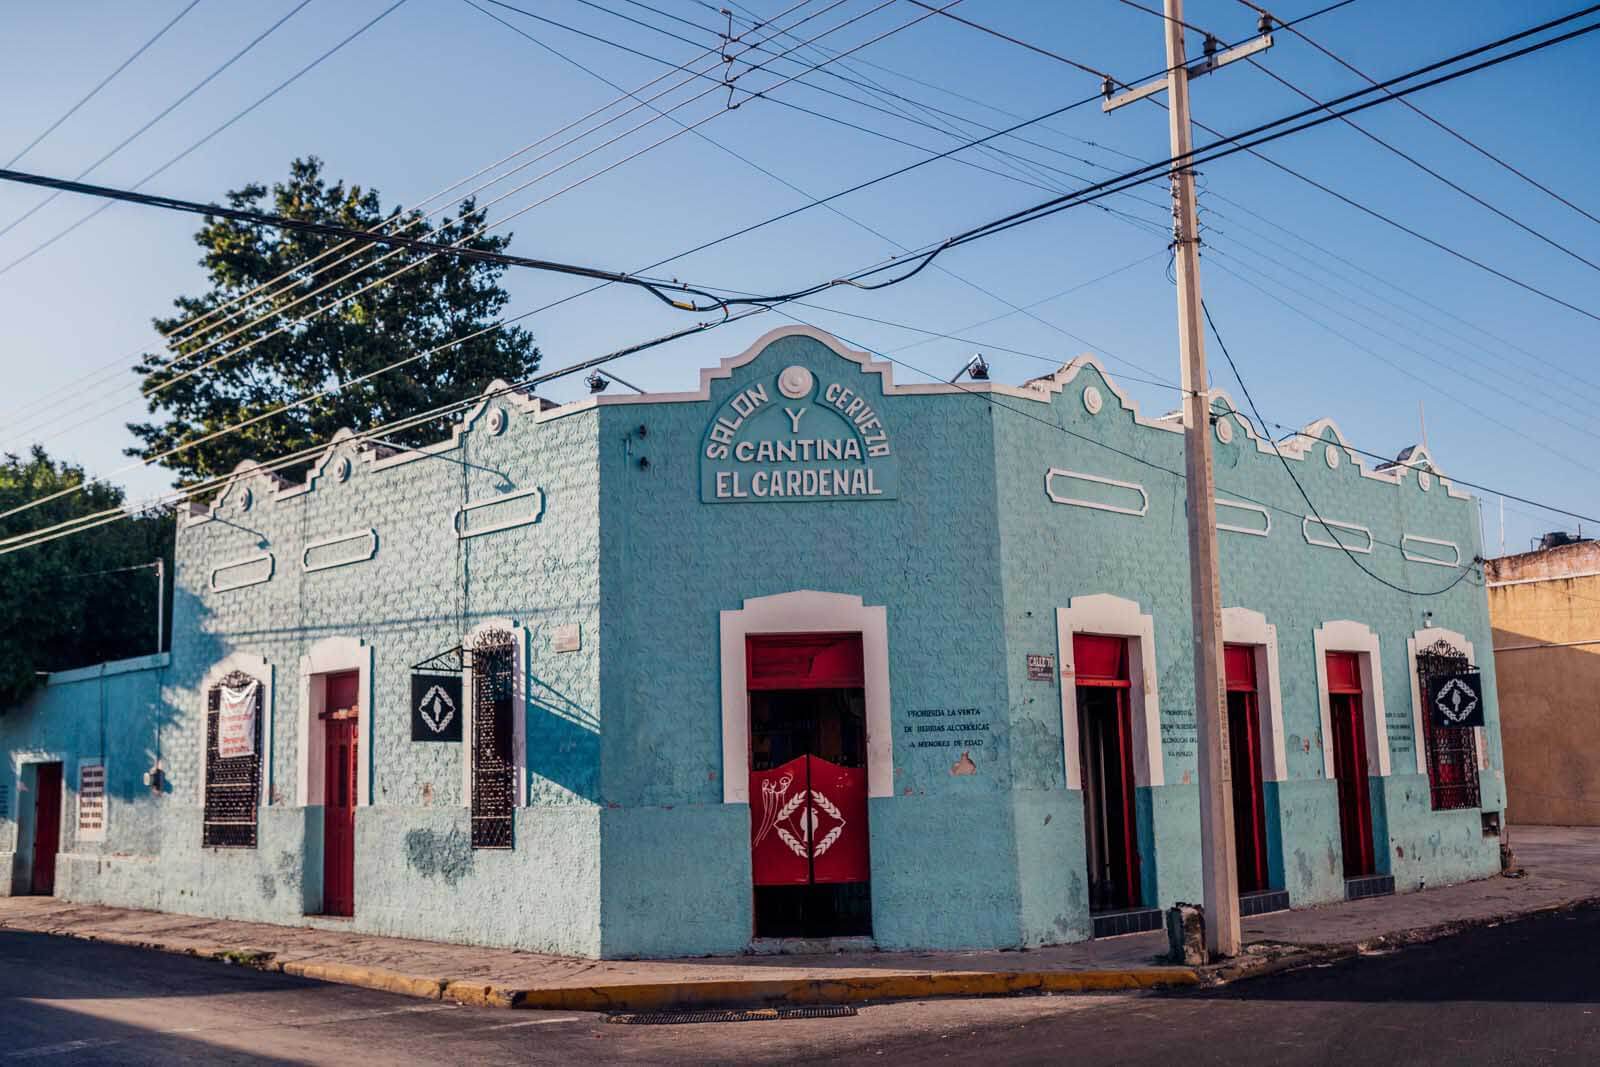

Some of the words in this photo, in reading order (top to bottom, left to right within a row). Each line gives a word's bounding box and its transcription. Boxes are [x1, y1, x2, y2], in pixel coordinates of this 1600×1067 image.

[706, 383, 768, 460] SALON
[784, 407, 806, 433] Y
[825, 383, 890, 457] CERVEZA
[735, 438, 862, 462] CANTINA
[716, 471, 747, 498] EL
[752, 468, 882, 497] CARDENAL
[957, 708, 981, 716] VENTA
